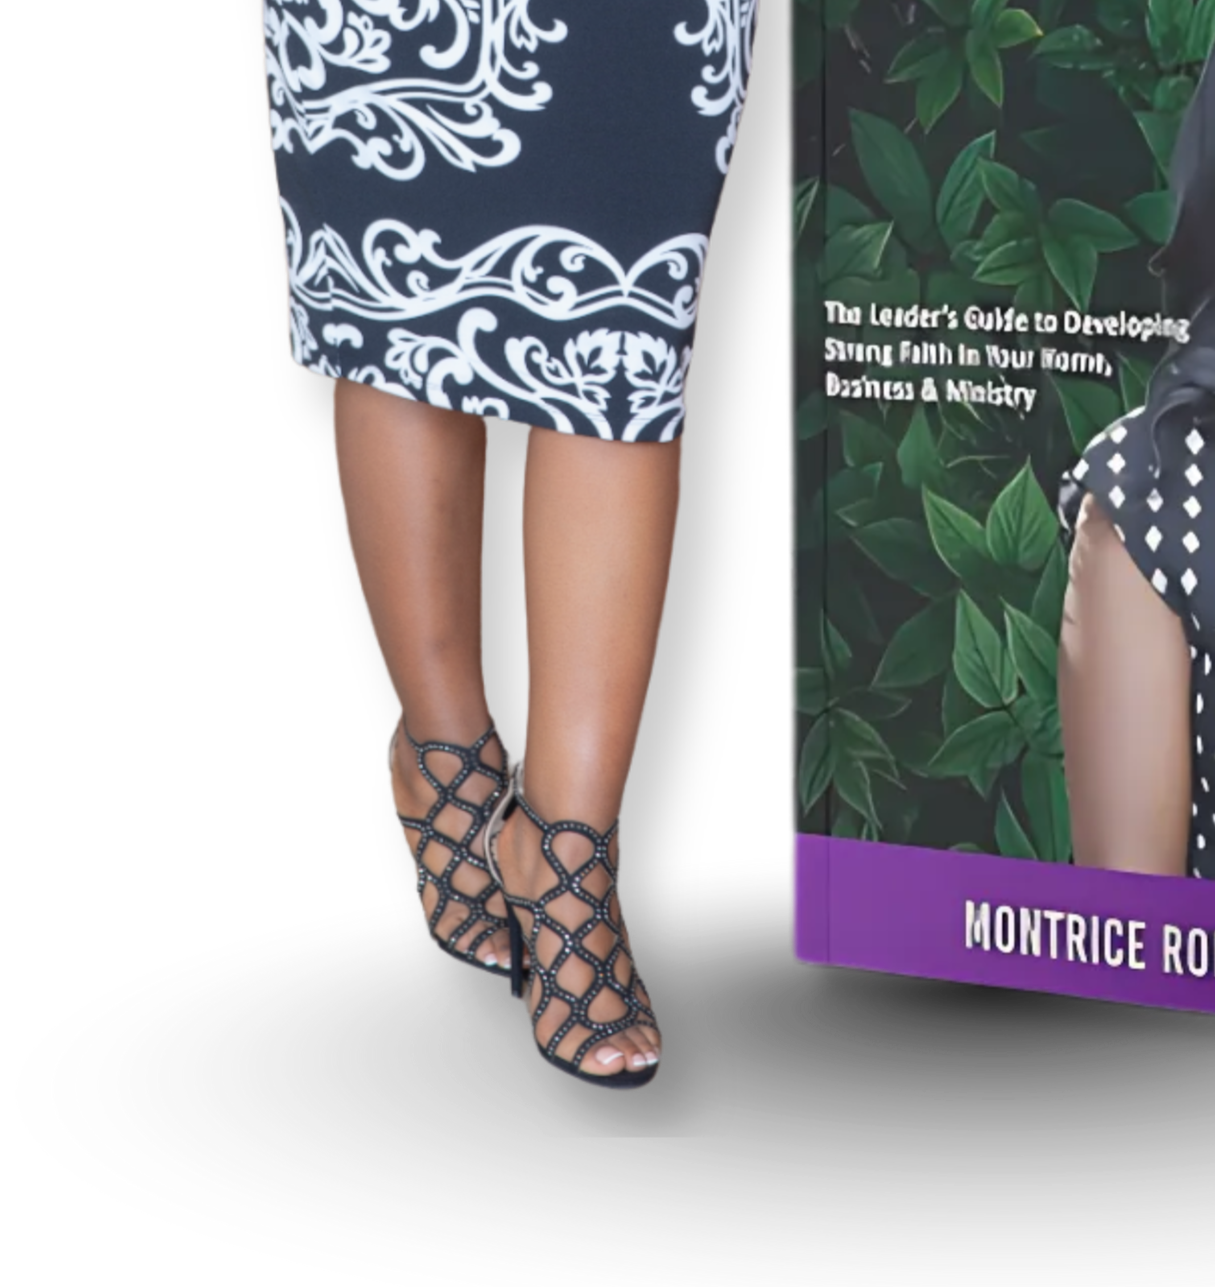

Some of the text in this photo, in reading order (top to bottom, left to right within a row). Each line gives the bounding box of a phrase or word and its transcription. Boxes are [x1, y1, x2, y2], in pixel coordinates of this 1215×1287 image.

[1034, 308, 1056, 332] to
[1064, 310, 1191, 344] Developing
[965, 900, 1146, 970] MONTRICE
